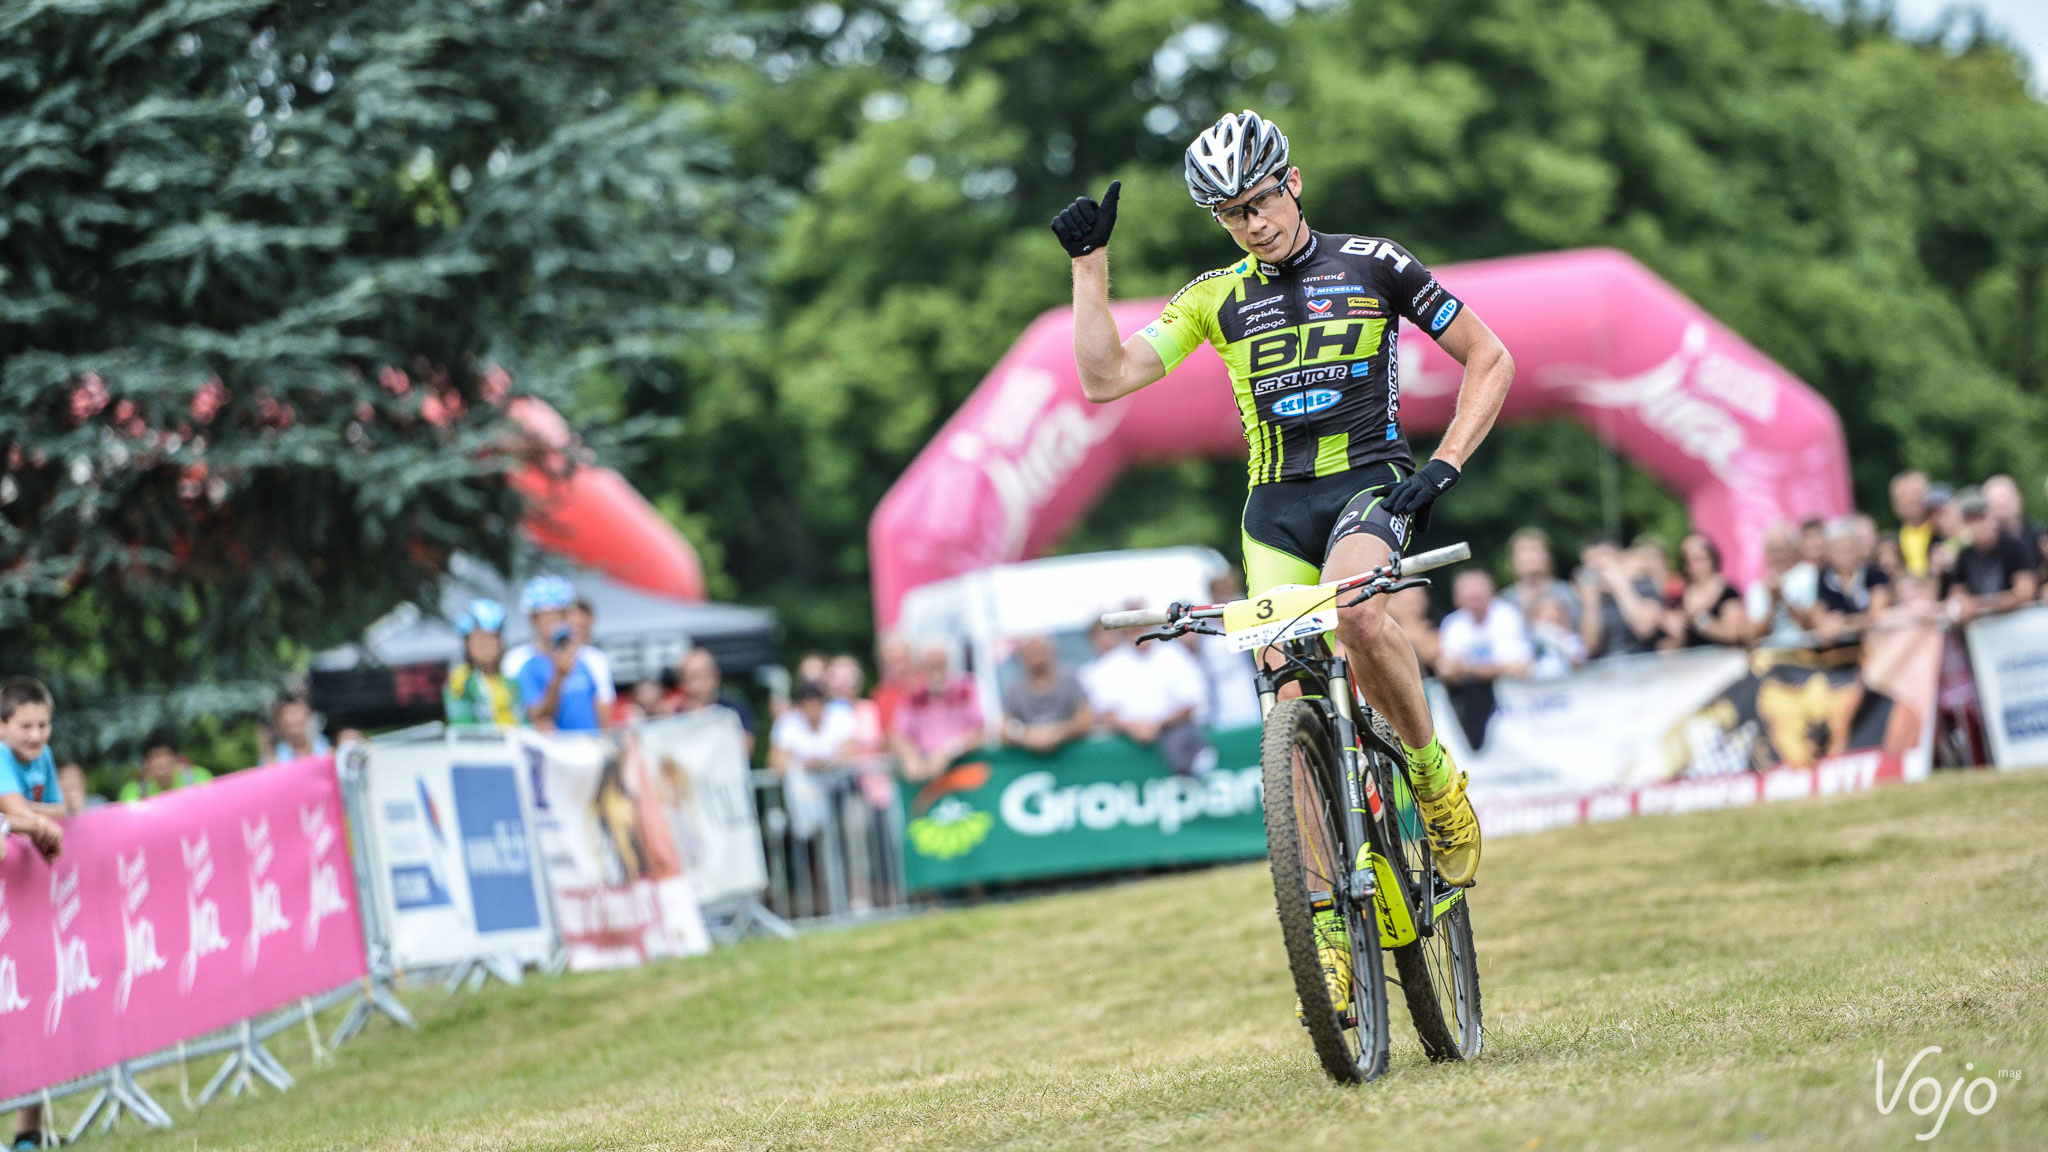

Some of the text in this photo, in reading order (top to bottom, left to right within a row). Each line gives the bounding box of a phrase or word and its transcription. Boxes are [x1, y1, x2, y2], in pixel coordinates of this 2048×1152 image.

[1316, 286, 1362, 294] MICHELIN
[1433, 301, 1455, 327] KMC
[1242, 318, 1287, 337] prologo
[1250, 323, 1364, 374] BH
[1281, 392, 1332, 413] KMC
[1256, 600, 1274, 620] 3
